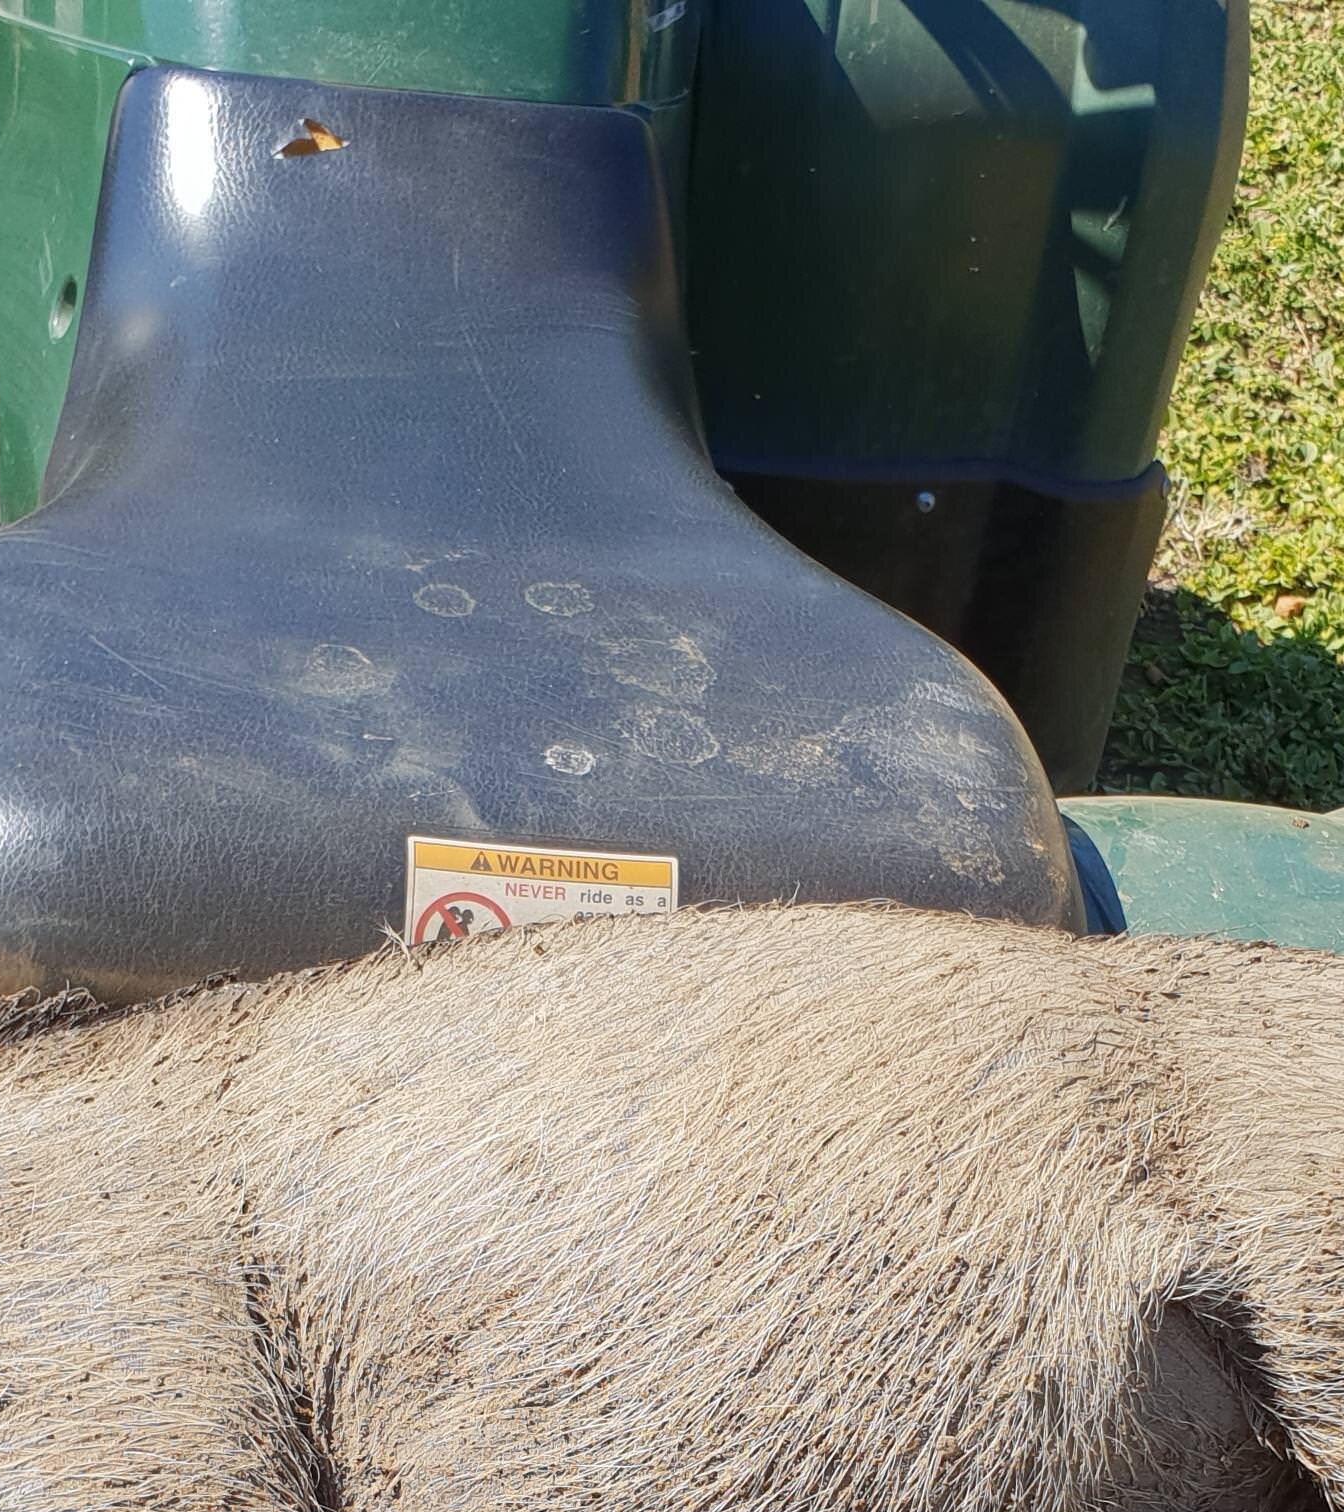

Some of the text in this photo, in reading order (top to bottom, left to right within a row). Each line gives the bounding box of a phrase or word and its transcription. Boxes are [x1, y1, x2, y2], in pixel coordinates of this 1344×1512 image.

[497, 854, 619, 881] WARNING
[505, 883, 666, 907] NEVER ride as a
